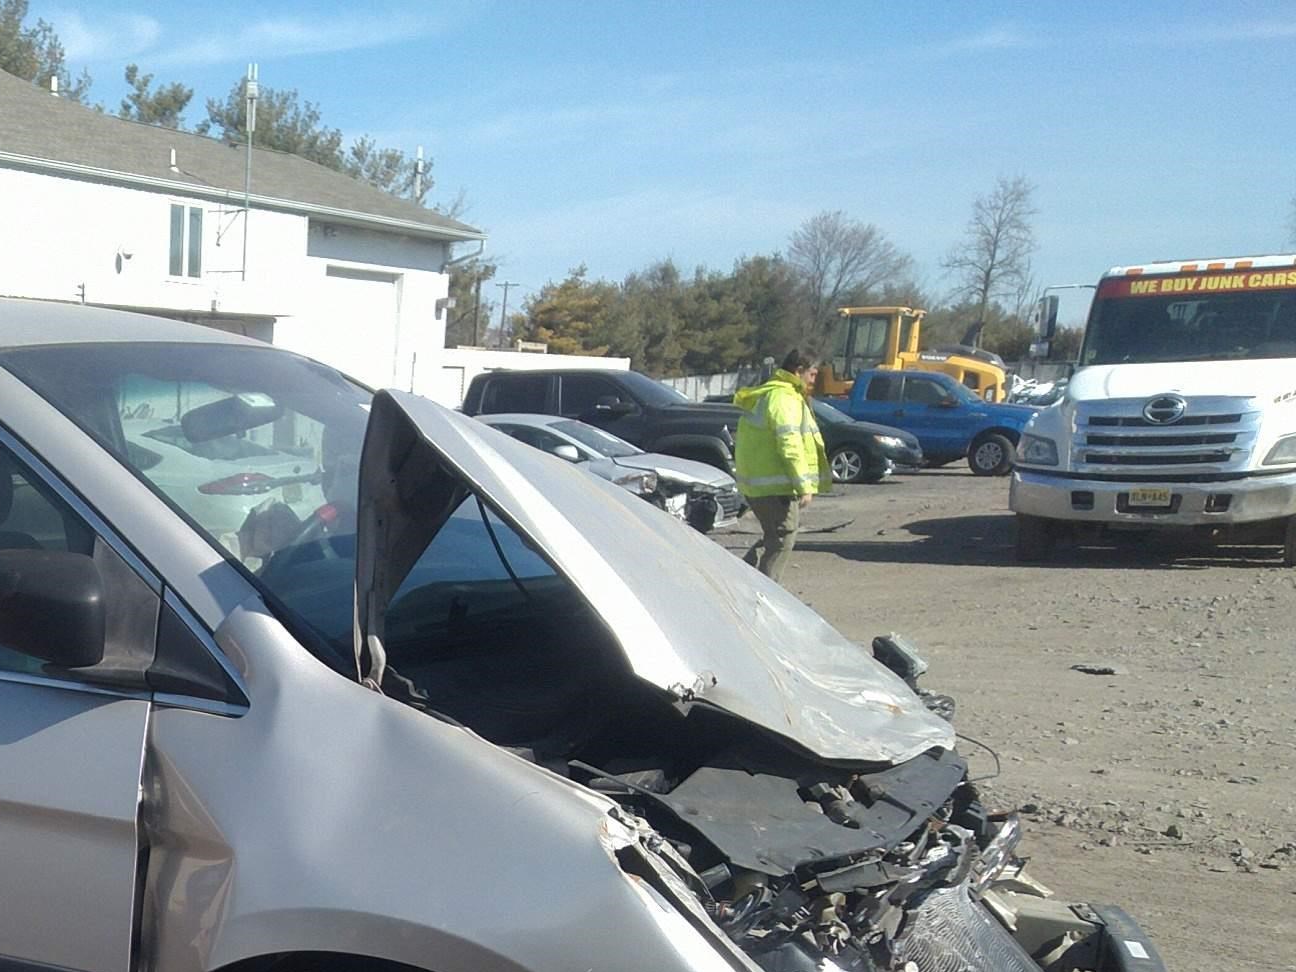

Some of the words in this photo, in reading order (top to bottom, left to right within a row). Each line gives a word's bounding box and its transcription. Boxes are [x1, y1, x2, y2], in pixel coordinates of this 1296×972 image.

[1130, 280, 1158, 295] WE
[1161, 277, 1198, 292] BUY
[1198, 275, 1245, 290] JUNK
[1248, 271, 1296, 288] CARS
